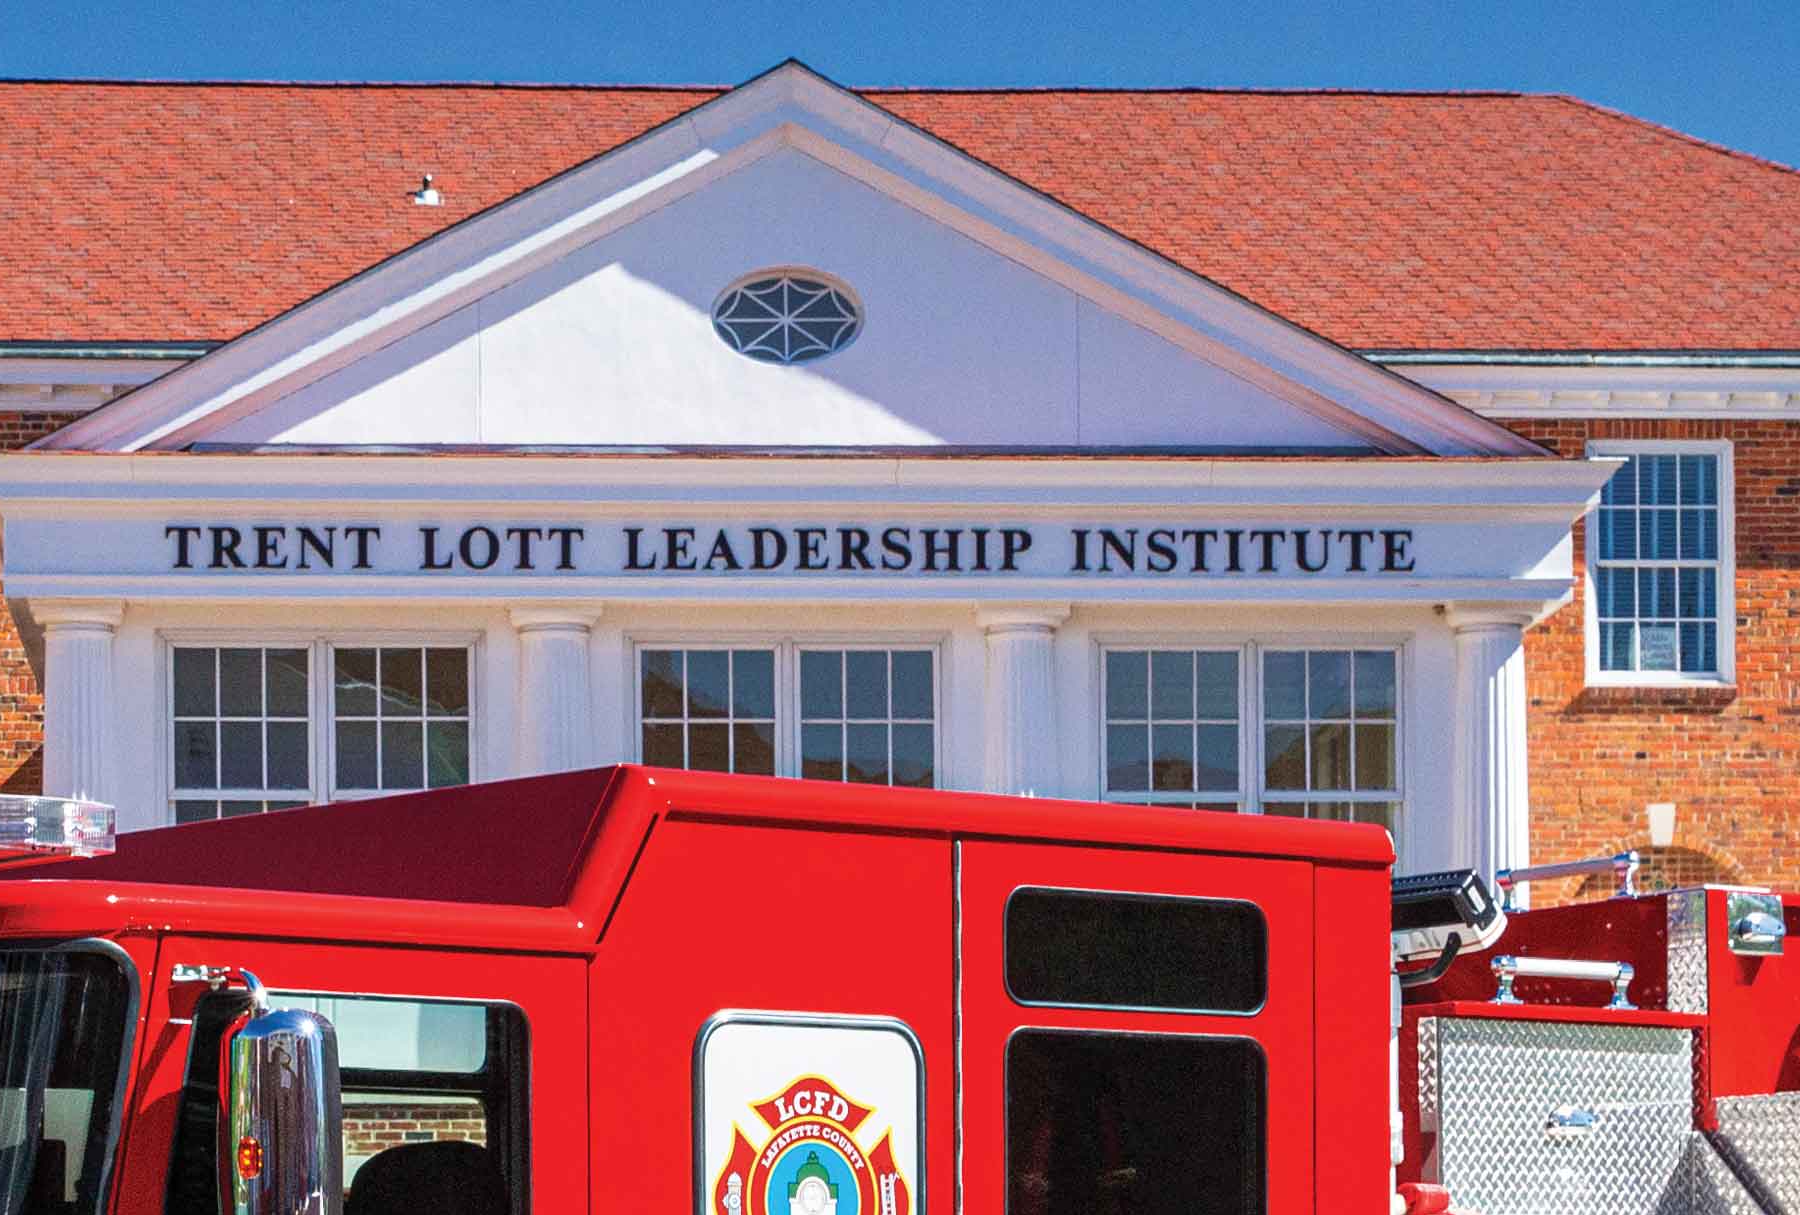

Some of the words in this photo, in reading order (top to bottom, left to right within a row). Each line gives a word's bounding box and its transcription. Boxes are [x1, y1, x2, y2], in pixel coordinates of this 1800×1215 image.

[165, 526, 381, 569] TRENT
[419, 527, 584, 570] LOTT
[622, 528, 1033, 573] LEADERSHIP
[1071, 529, 1416, 573] INSTITUTE
[774, 1090, 849, 1122] LCFD
[761, 1124, 820, 1169] LAFAYETTE
[821, 1127, 865, 1170] COUNTY
